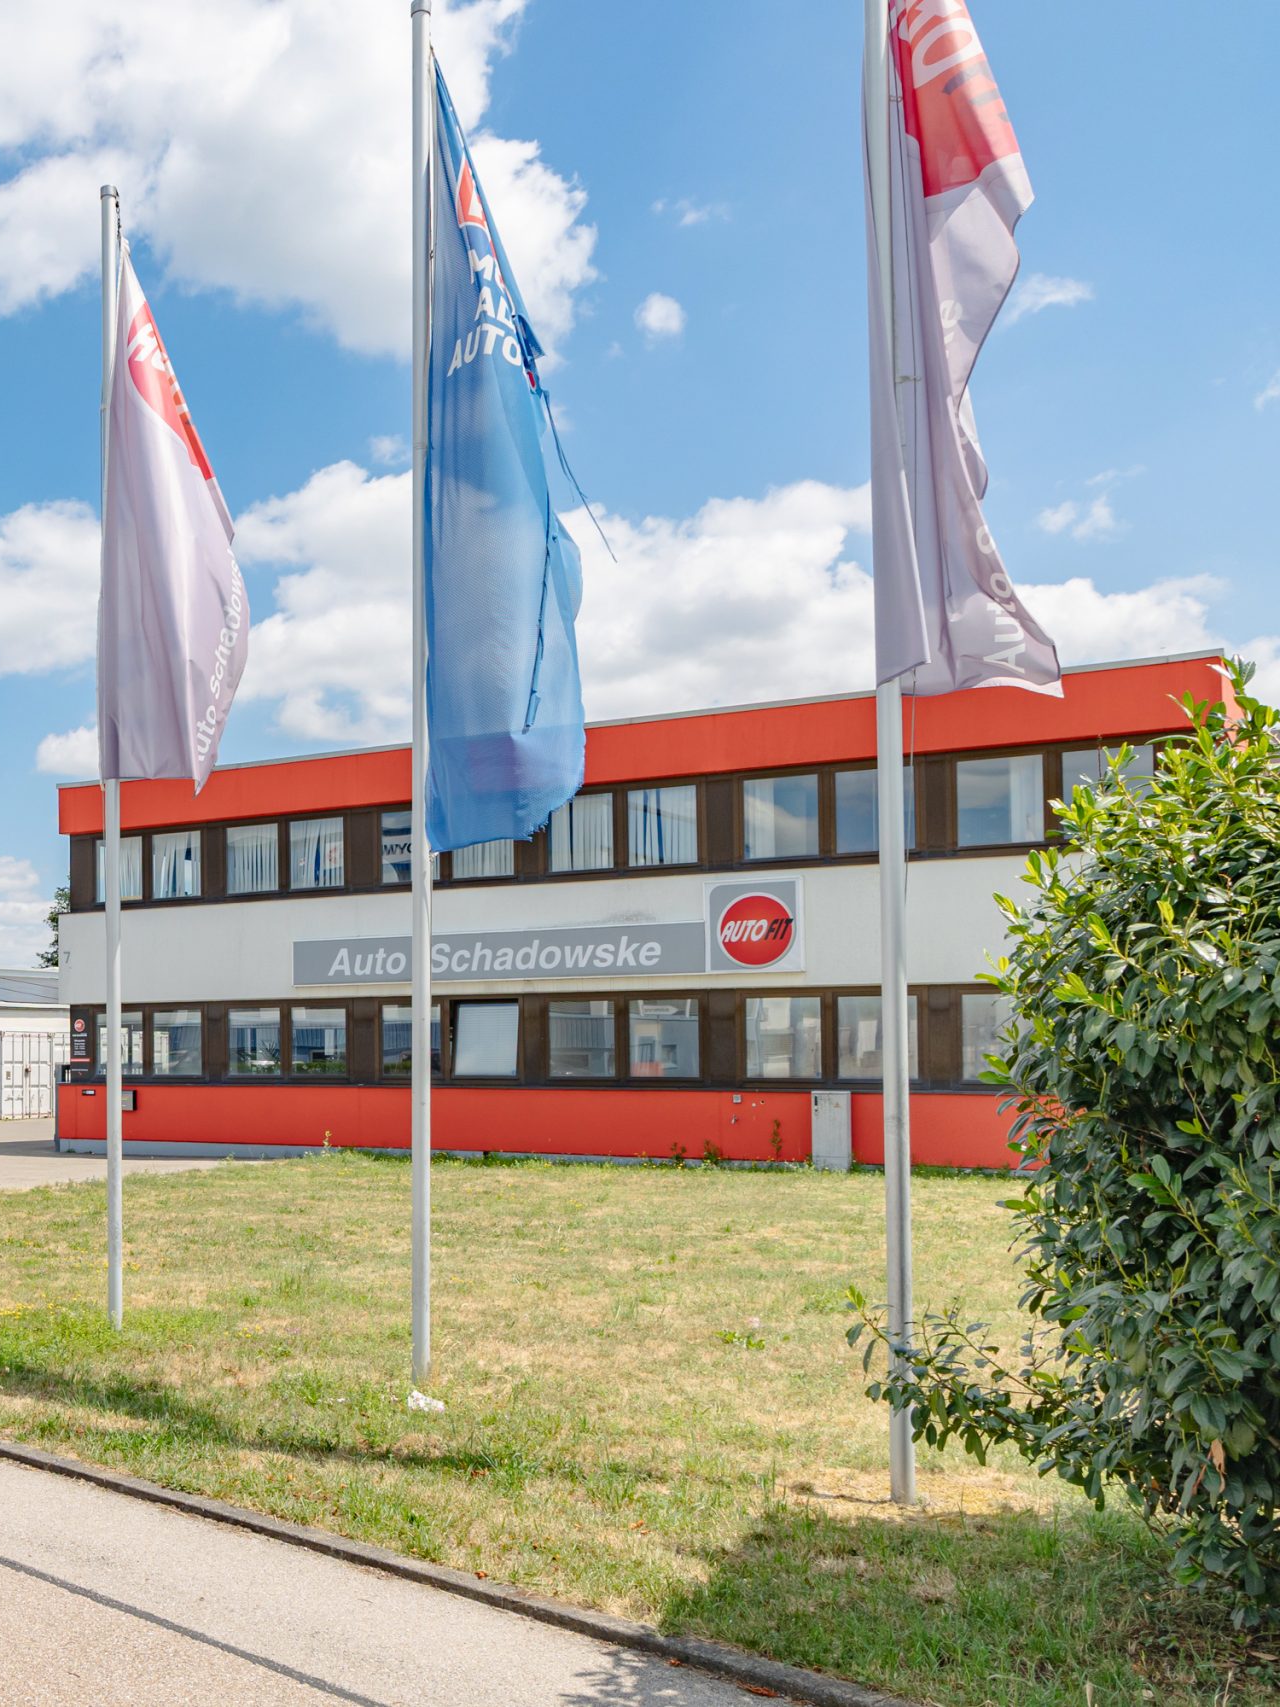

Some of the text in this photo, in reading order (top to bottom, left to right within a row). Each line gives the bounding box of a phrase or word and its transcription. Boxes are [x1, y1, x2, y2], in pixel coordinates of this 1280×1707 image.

[196, 549, 242, 762] uto Schadows
[63, 951, 71, 964] 7
[328, 935, 662, 976] Auto Schadowske
